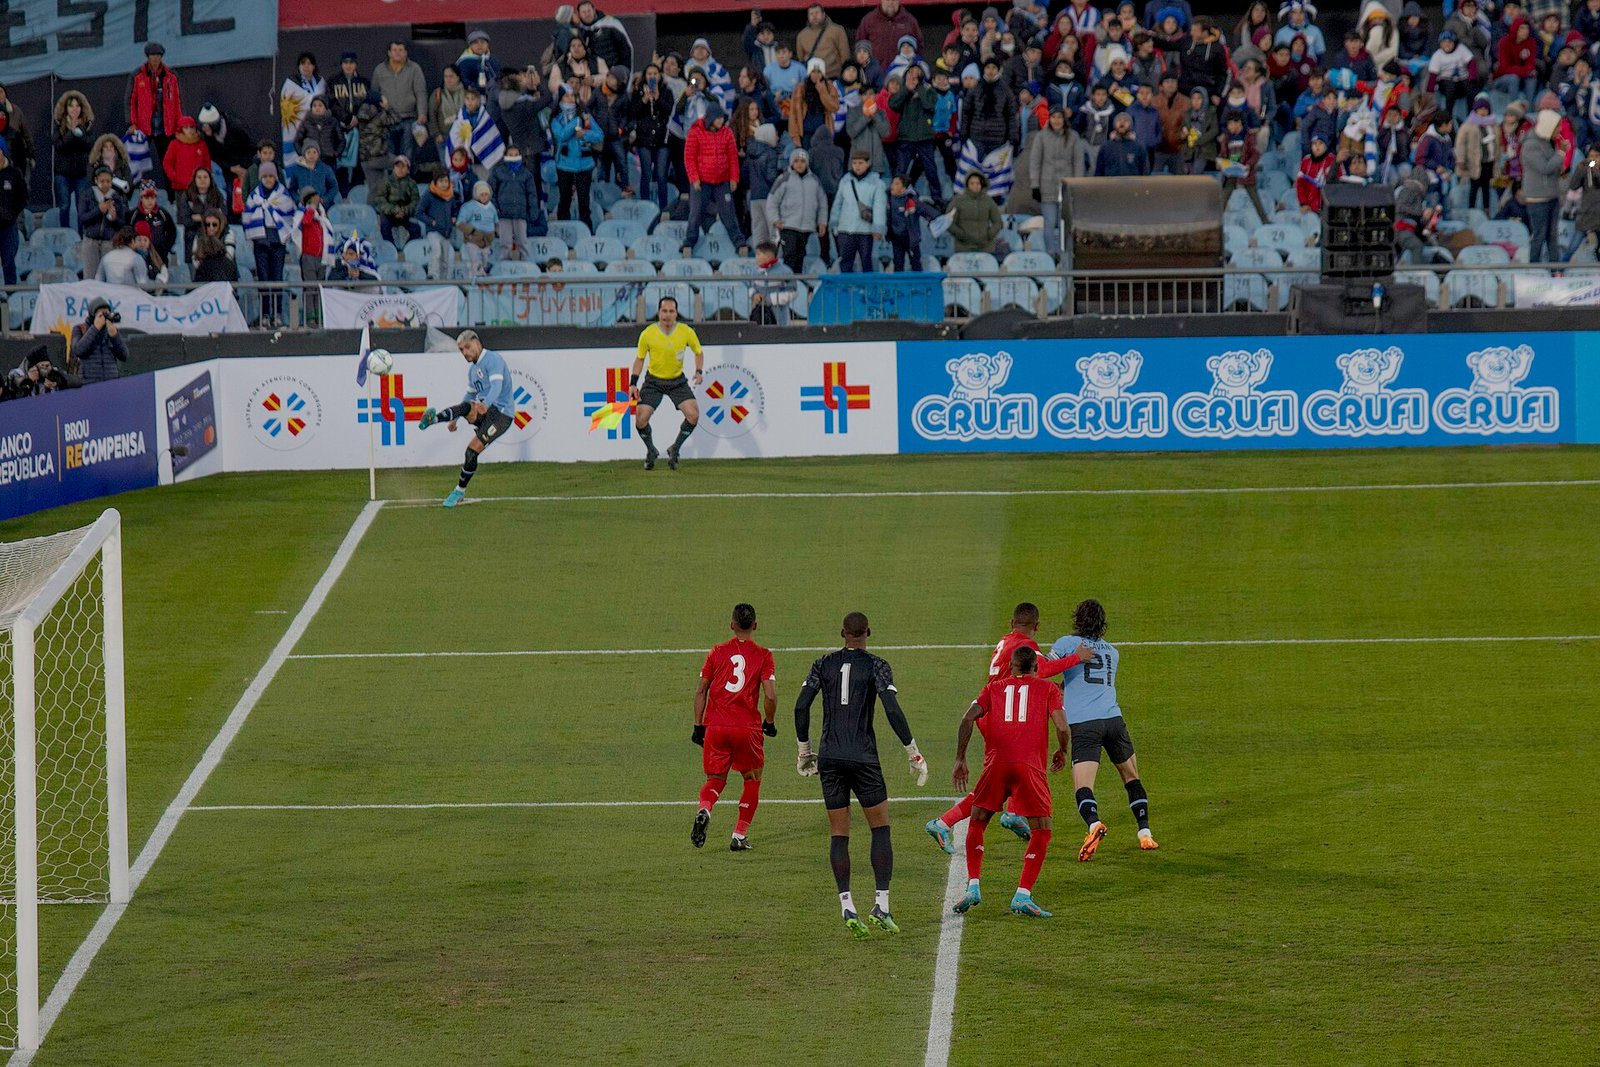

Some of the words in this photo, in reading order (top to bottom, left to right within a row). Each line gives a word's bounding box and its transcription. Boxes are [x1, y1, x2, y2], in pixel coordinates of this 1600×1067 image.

[334, 82, 367, 99] ITALIA
[536, 243, 548, 255] 16
[595, 242, 605, 254] 17
[709, 241, 720, 253] 19
[65, 295, 121, 317] BAY
[360, 297, 392, 321] CENTRO
[916, 396, 1034, 438] CRUFI
[1045, 395, 1164, 437] CRUFI
[1176, 394, 1295, 436] CRUFI
[1306, 391, 1425, 434] CRUFI
[1436, 390, 1556, 432] CRUFI
[0, 431, 32, 459] ANCO
[64, 419, 89, 441] BROU
[65, 430, 146, 469] RECOMPENSA
[724, 654, 746, 693] 3
[989, 639, 1006, 675] 2
[839, 663, 852, 705] 1
[1003, 684, 1029, 722] 11
